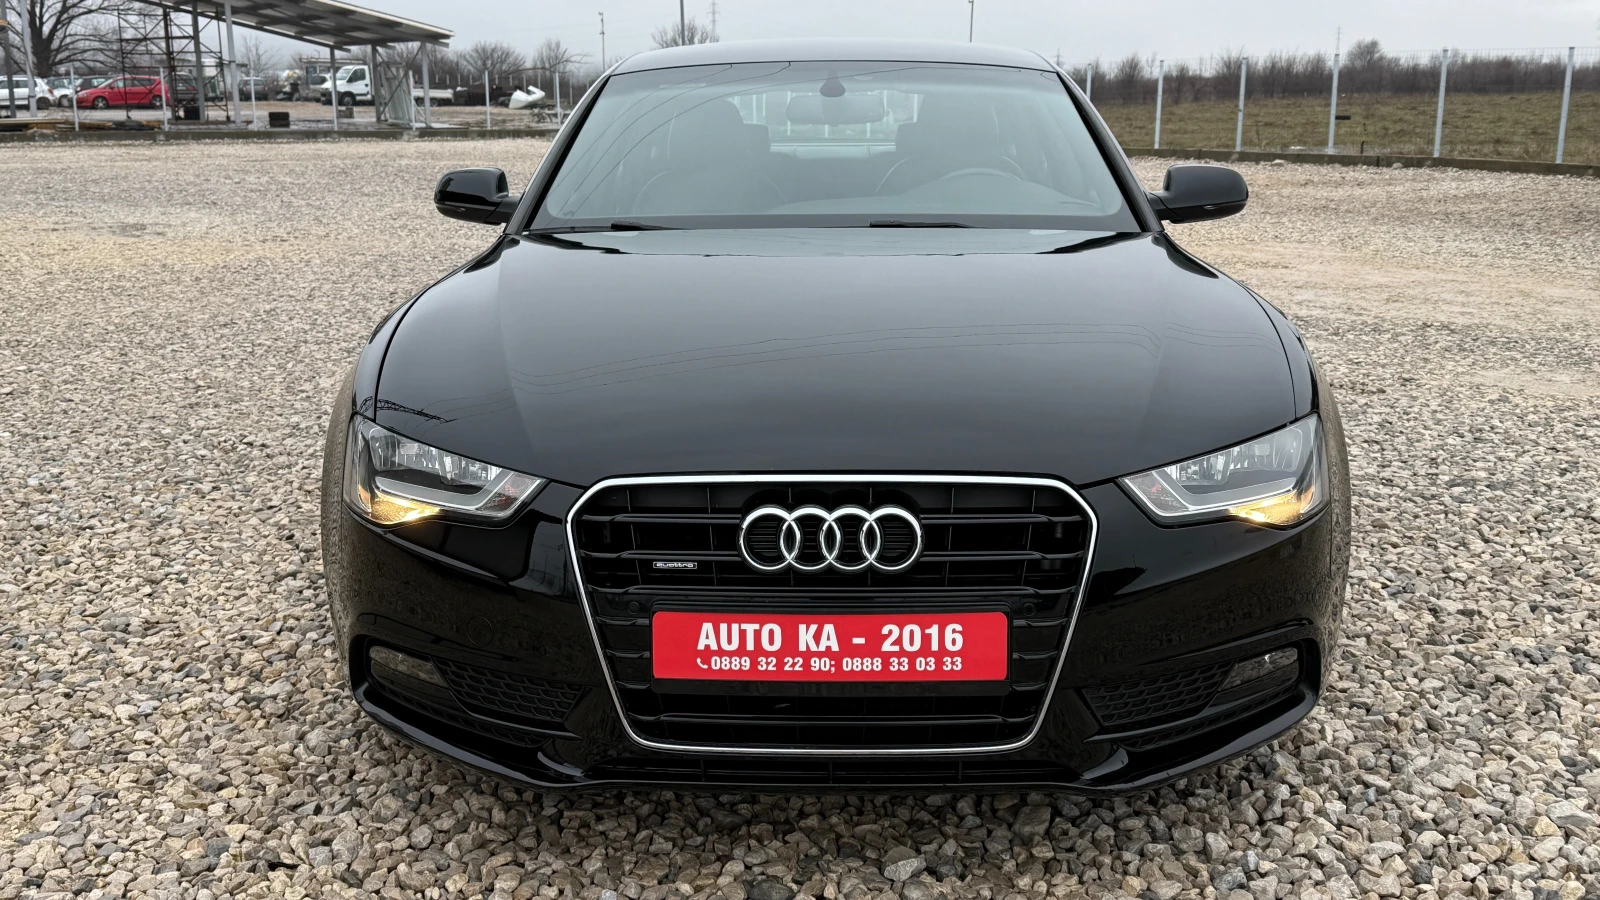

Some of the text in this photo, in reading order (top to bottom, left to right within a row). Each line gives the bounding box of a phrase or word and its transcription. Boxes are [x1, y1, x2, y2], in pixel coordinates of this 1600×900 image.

[696, 622, 782, 652] AUTO
[798, 623, 840, 652] KA
[881, 623, 964, 652] 2016
[711, 656, 963, 674] 0889 32 22 90; 0888 33 03 33
